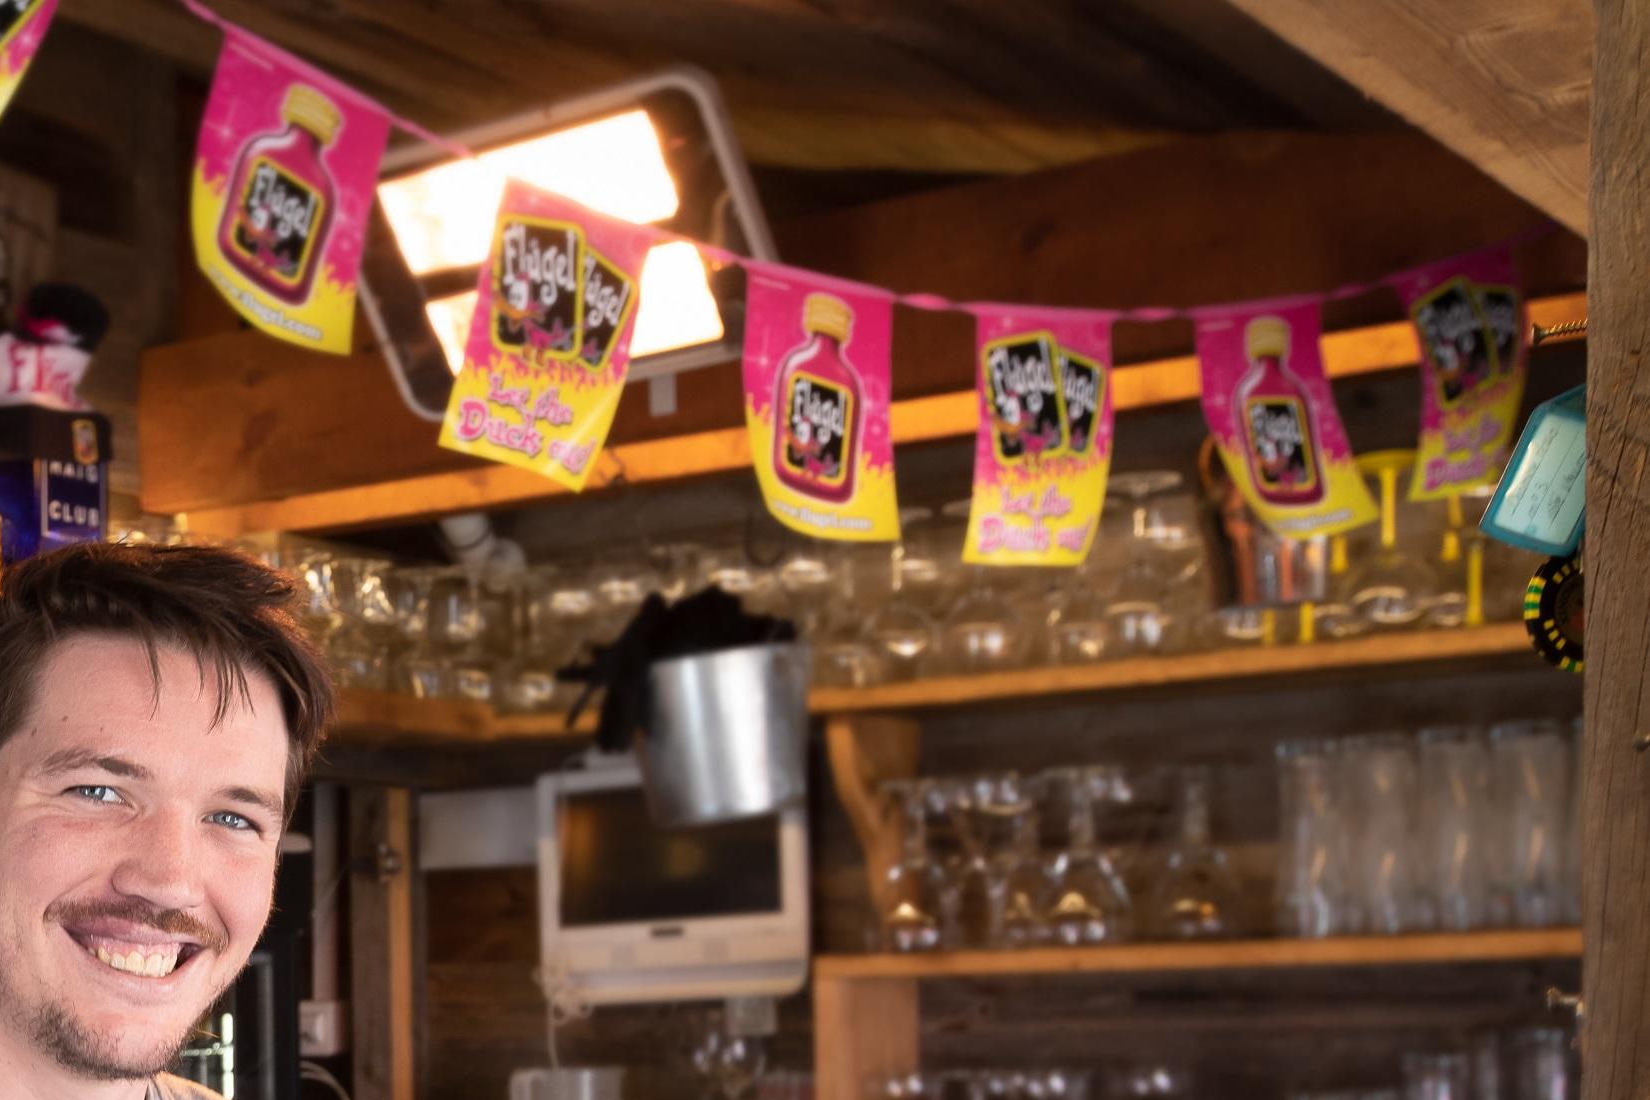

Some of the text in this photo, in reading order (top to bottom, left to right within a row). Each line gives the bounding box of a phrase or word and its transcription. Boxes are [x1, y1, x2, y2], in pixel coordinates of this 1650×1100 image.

[250, 164, 316, 238] Flügel
[503, 220, 577, 306] Flügel
[990, 335, 1055, 414] Flügel
[456, 398, 543, 458] Duck
[791, 378, 846, 445] Flügel
[48, 500, 100, 527] CLUB
